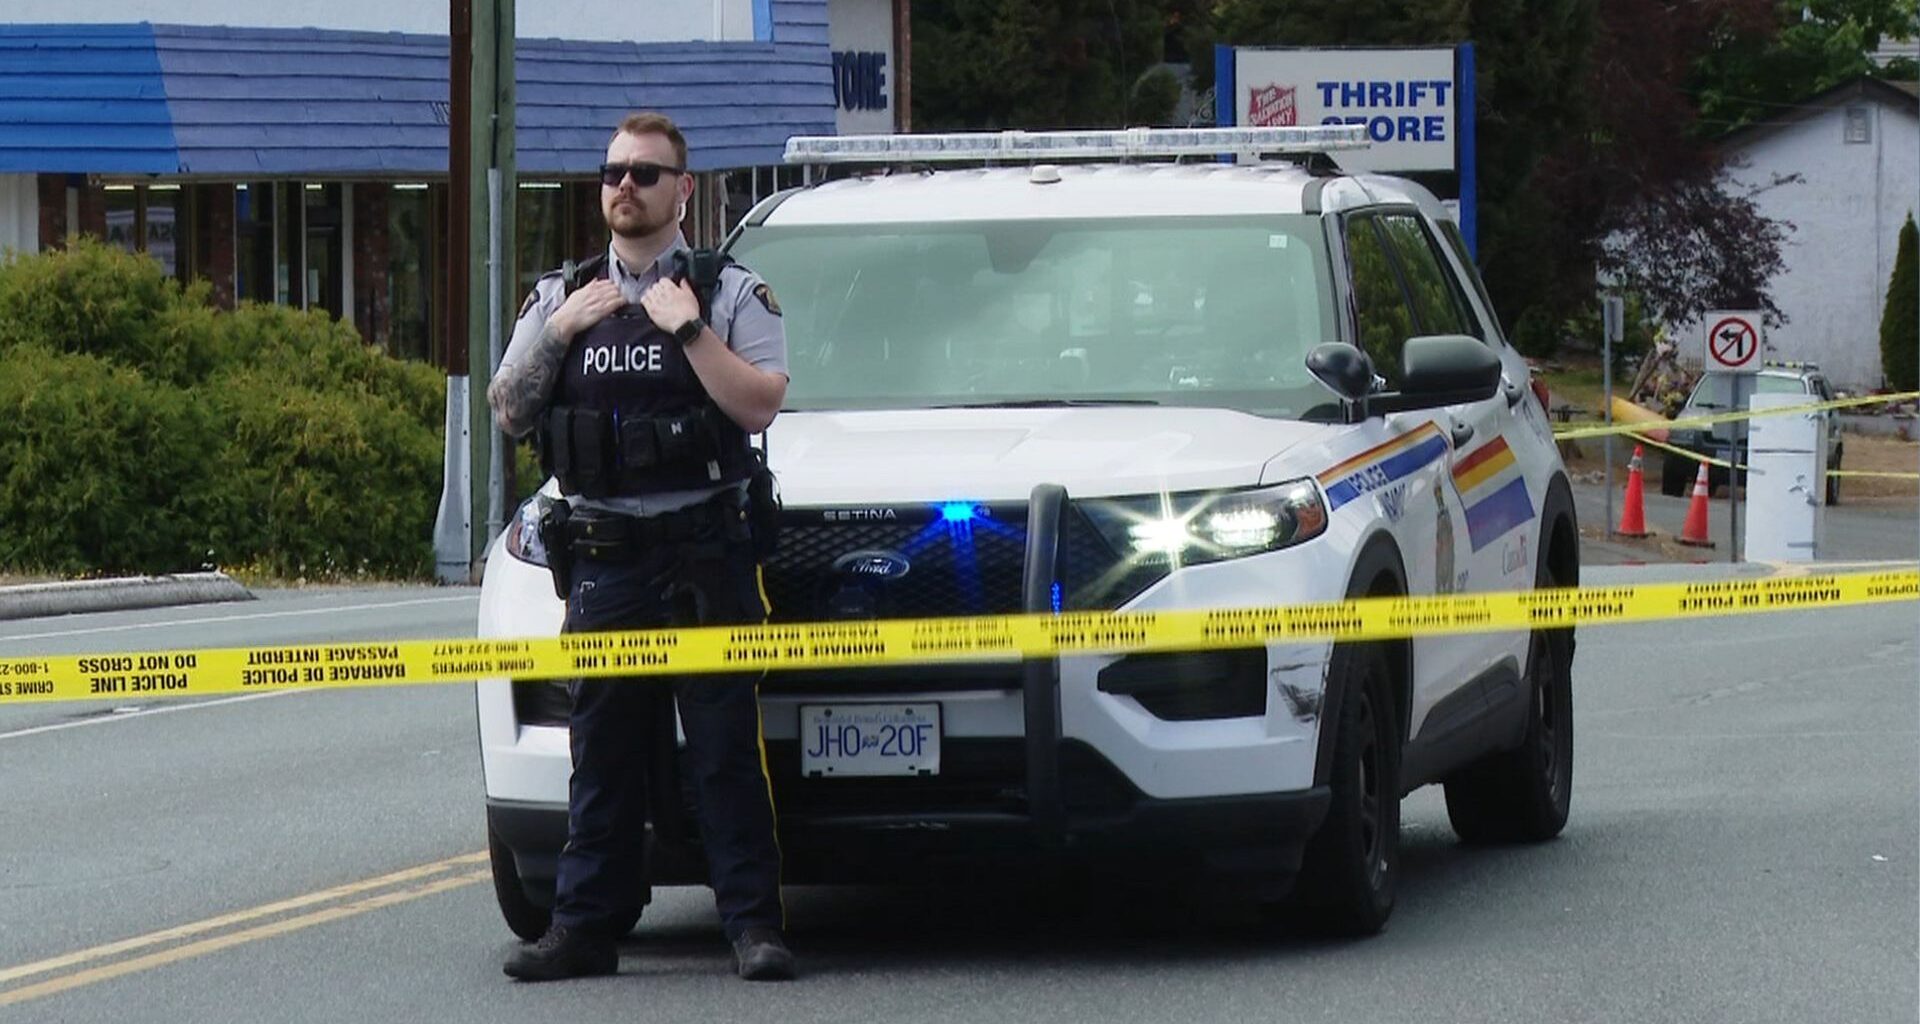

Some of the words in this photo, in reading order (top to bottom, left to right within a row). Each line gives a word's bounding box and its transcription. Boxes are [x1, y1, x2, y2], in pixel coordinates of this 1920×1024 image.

[1316, 80, 1452, 107] THRIFT
[583, 344, 662, 375] POLICE
[823, 508, 897, 521] SETINA
[1679, 596, 1734, 612] POLICE
[1740, 594, 1760, 608] DE
[1767, 589, 1841, 606] BARRAGE
[174, 654, 197, 669] DO
[247, 648, 320, 665] INTERDIT
[325, 646, 399, 662] PASSAGE
[574, 654, 607, 670] LINE
[613, 652, 669, 668] POLICE
[78, 657, 133, 673] CROSS
[138, 655, 169, 670] NOT
[431, 659, 493, 675] STOPPERS
[242, 668, 298, 685] POLICE
[303, 667, 324, 682] DE
[329, 663, 406, 681] BARRAGE
[16, 680, 54, 695] CRIME
[90, 676, 126, 693] LINE
[132, 673, 188, 691] POLICE
